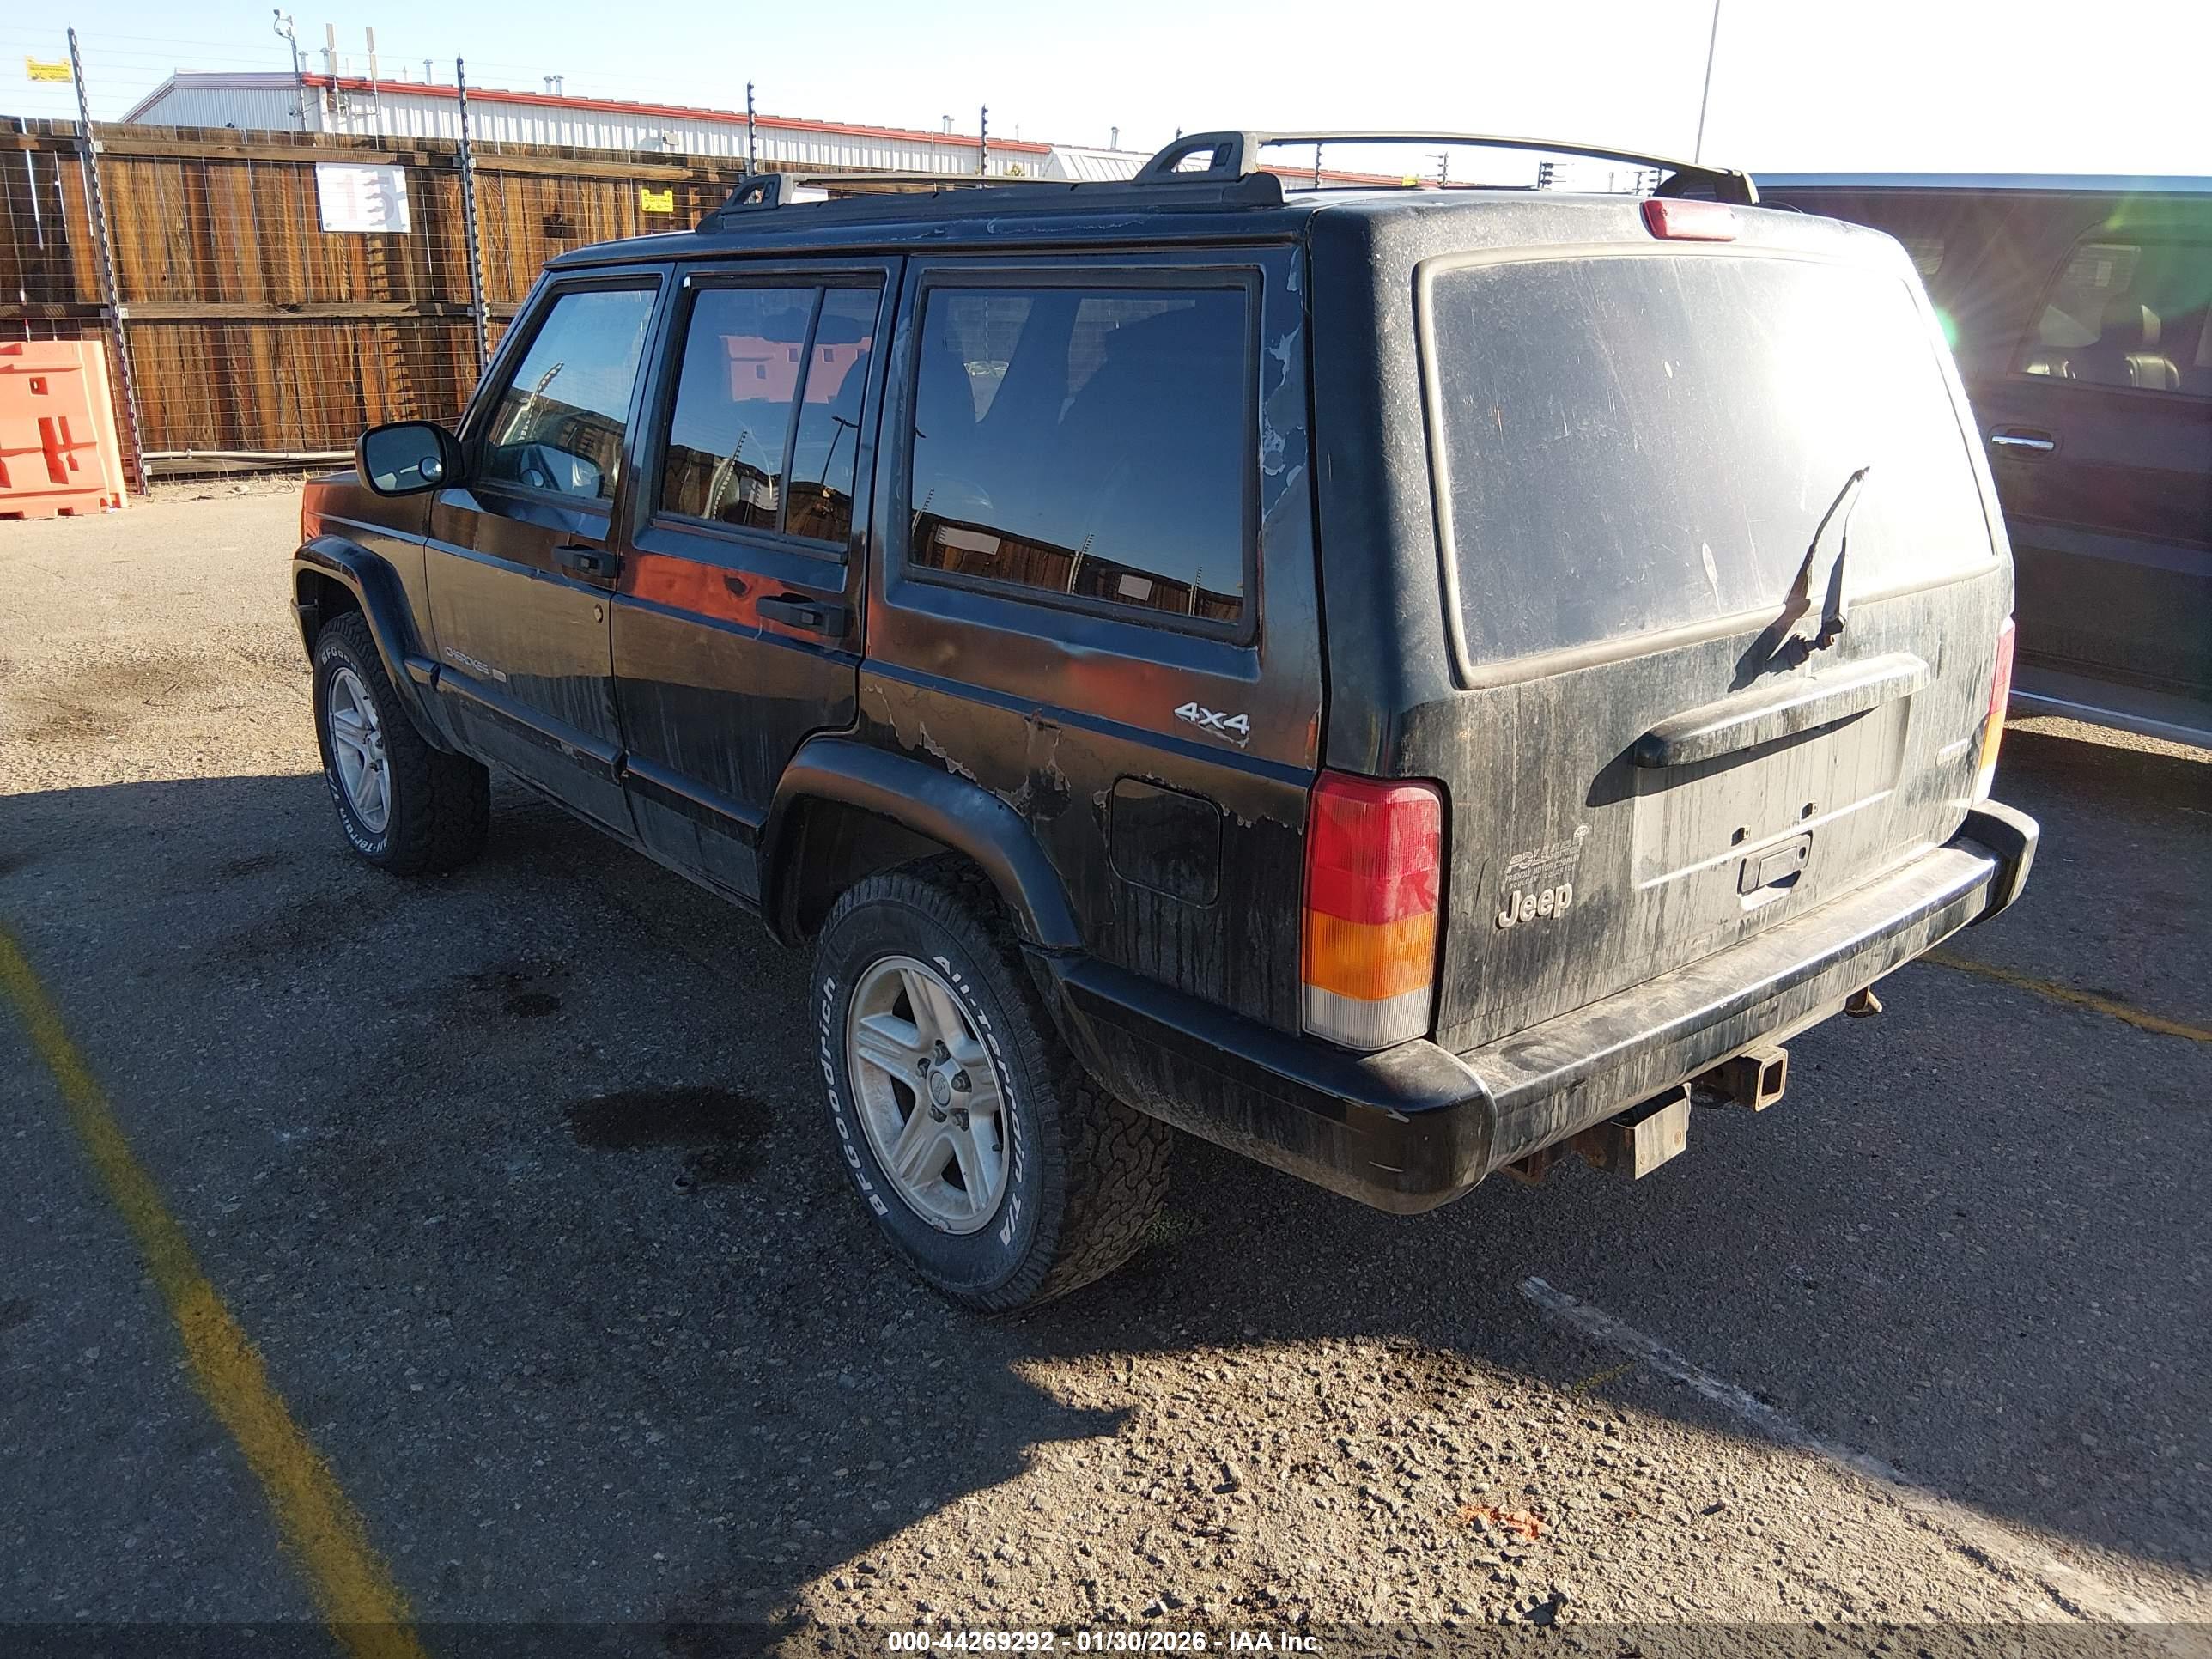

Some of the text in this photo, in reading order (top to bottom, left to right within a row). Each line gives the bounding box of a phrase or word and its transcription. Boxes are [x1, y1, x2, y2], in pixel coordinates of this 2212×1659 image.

[1498, 882, 1572, 927] Jeep
[820, 975, 889, 1216] BFGoodrich
[933, 955, 1024, 1246] All-Terrain T/A
